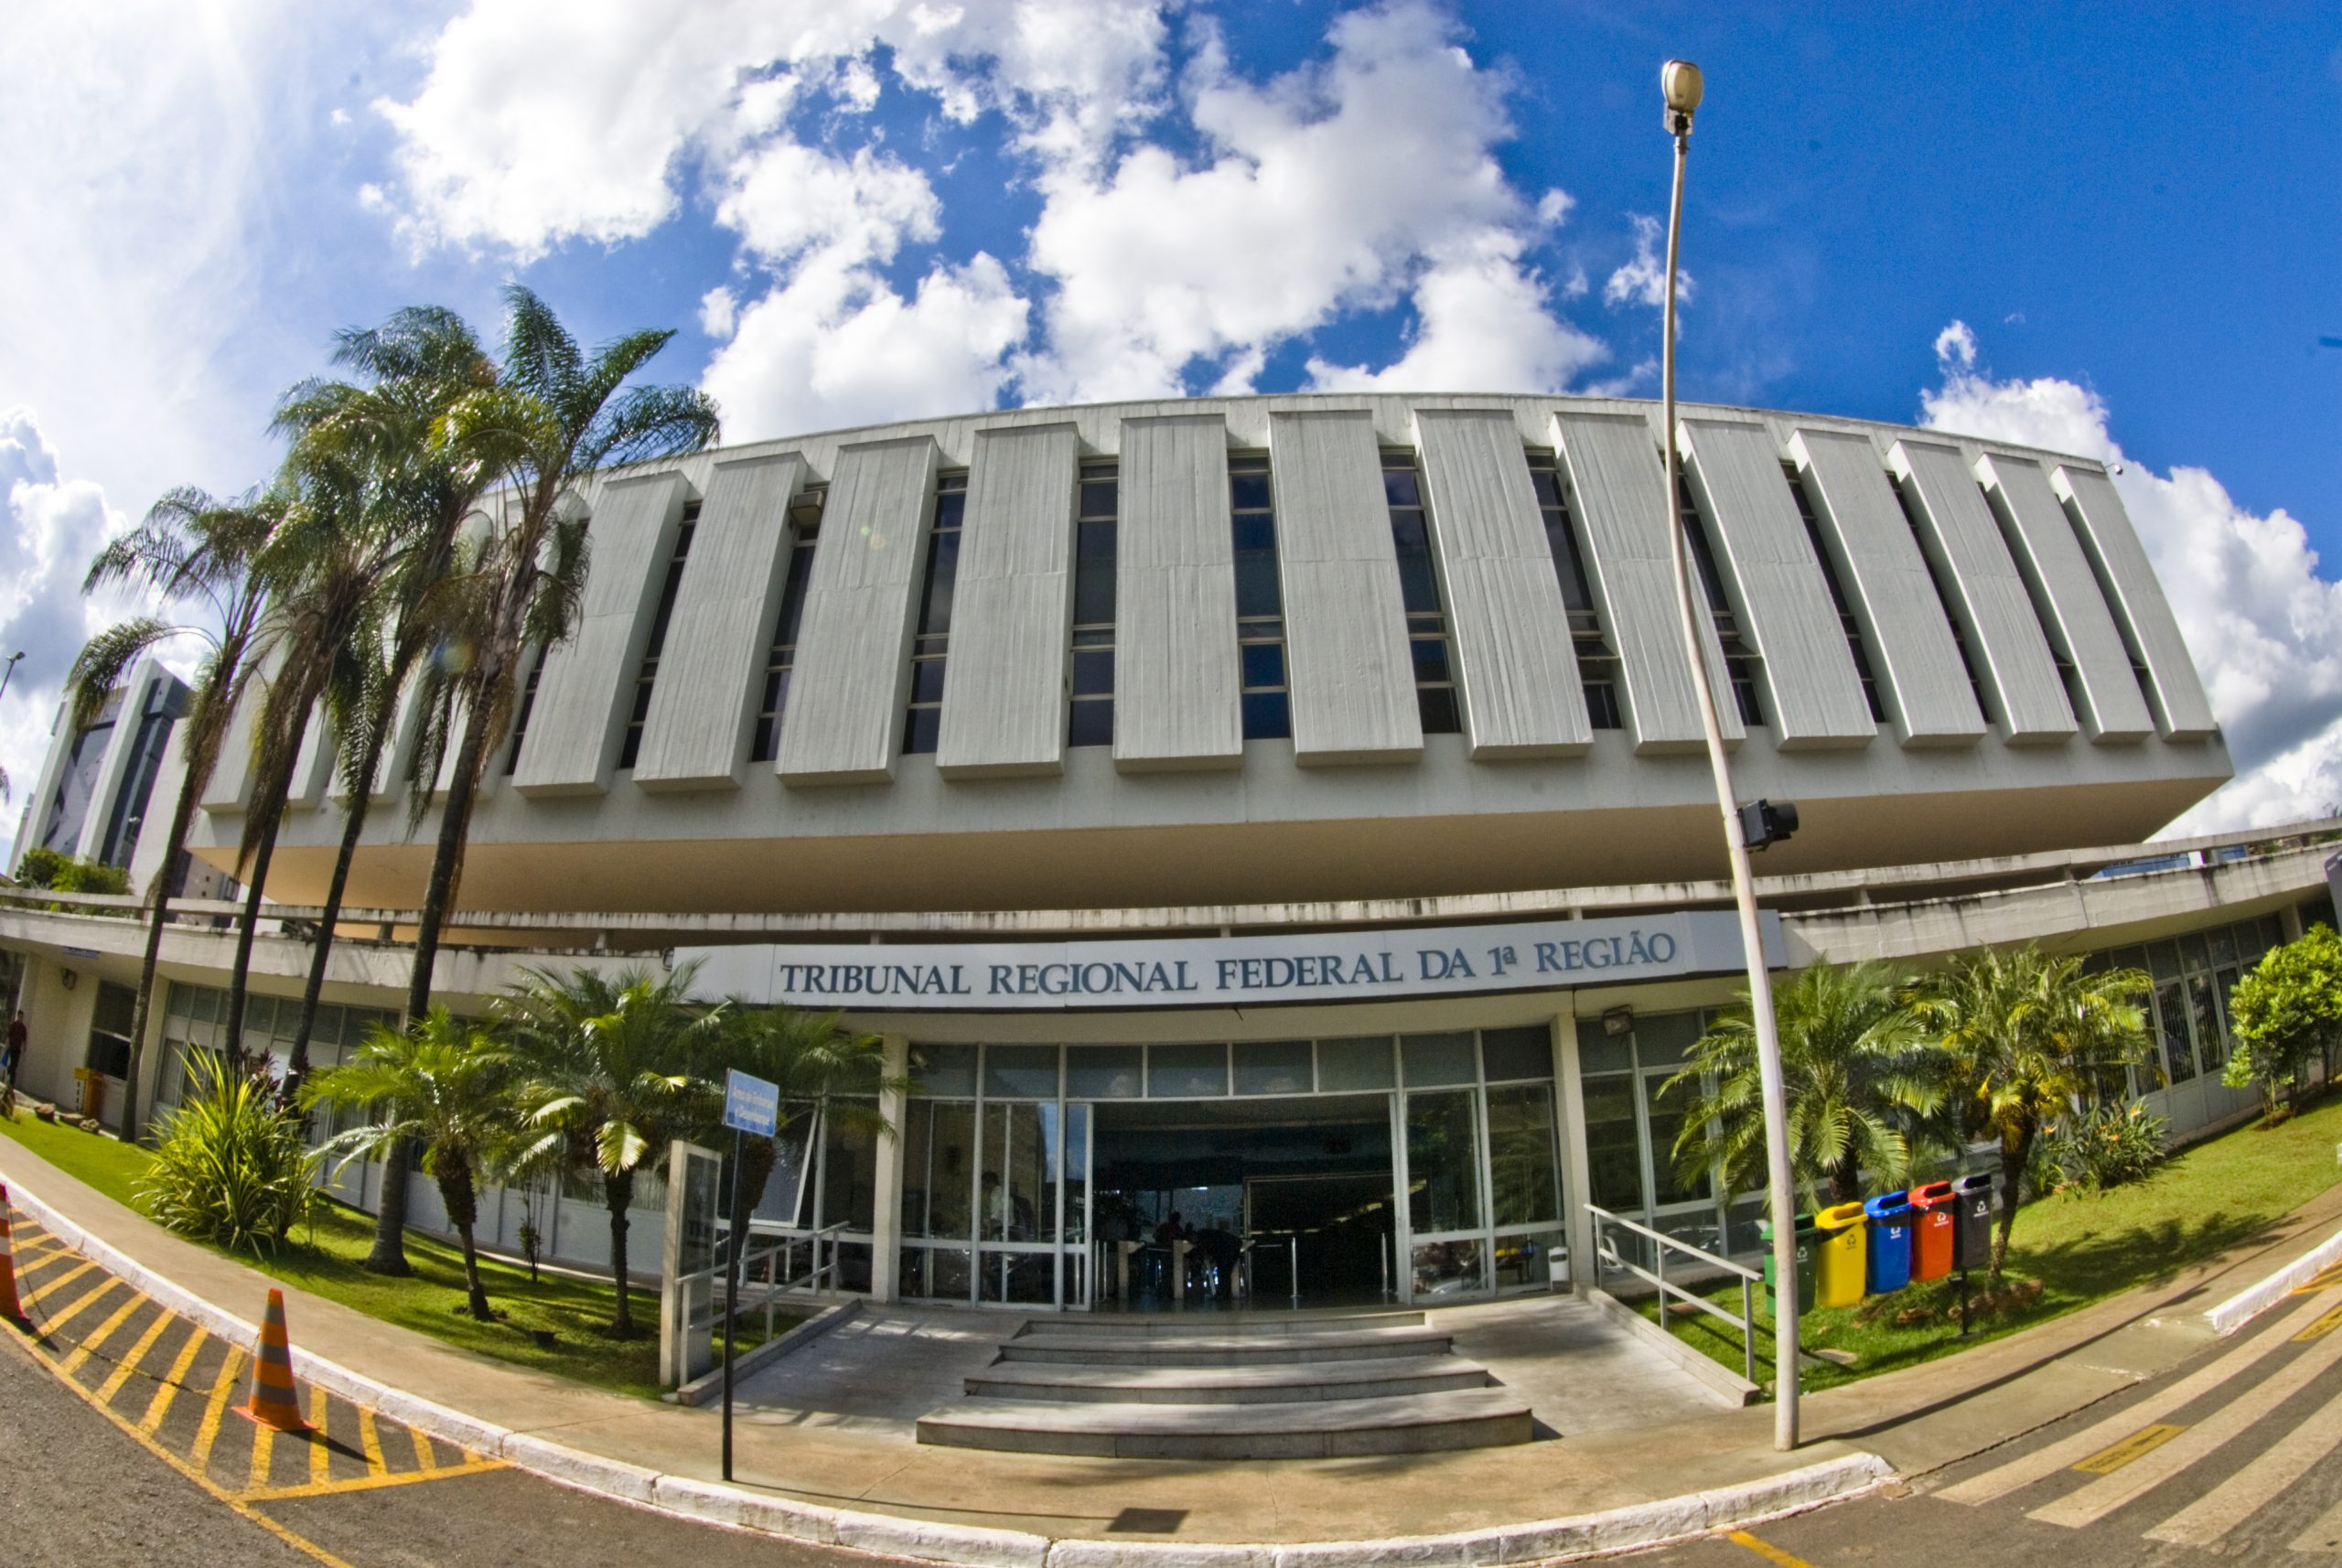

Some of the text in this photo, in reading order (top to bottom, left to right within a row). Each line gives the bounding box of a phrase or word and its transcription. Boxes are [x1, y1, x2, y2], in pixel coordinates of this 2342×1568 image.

[780, 929, 1676, 995] TRIBUNAL REGIONAL FEDERAL DA 1ª REGIÃO
